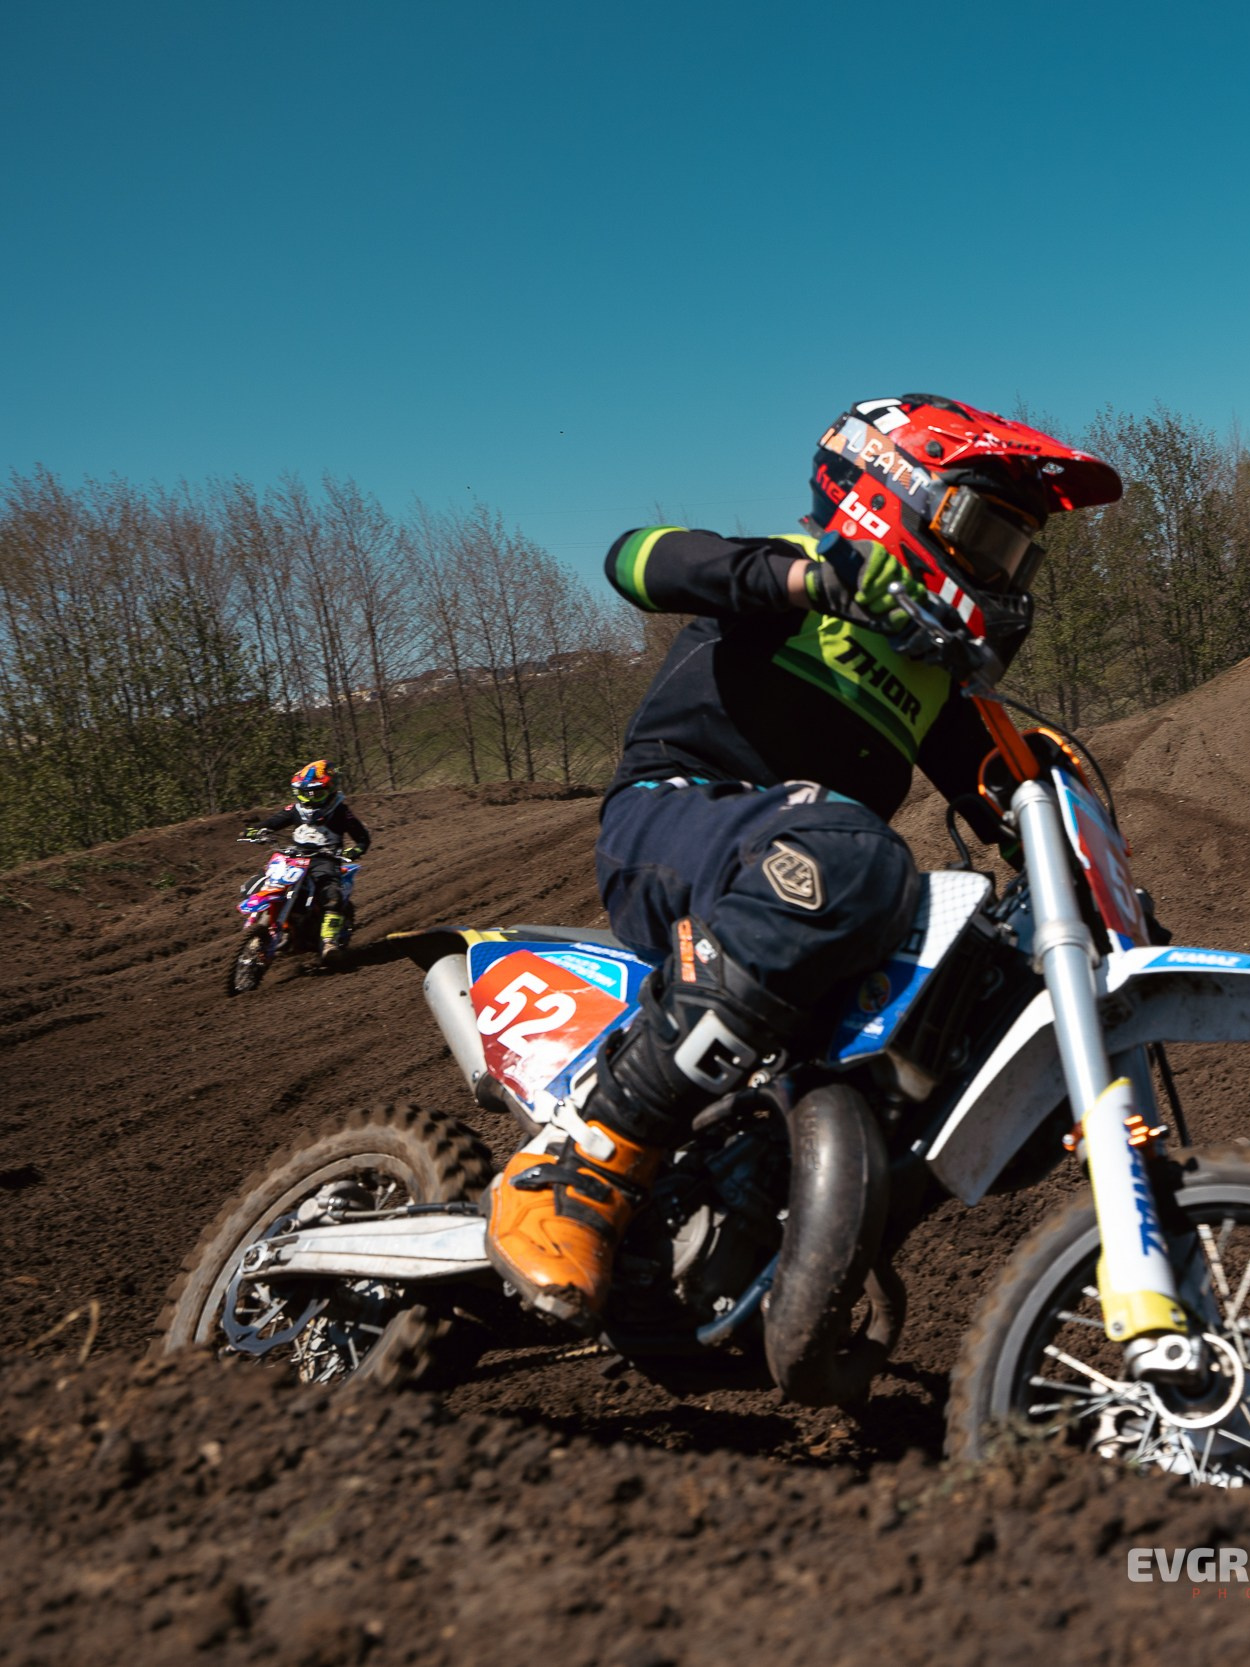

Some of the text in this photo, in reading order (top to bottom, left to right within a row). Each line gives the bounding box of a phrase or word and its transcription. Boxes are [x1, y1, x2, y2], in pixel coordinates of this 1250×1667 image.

[816, 463, 891, 540] hebo
[847, 429, 931, 497] LEATT
[834, 634, 922, 727] THOR
[476, 971, 577, 1060] 52
